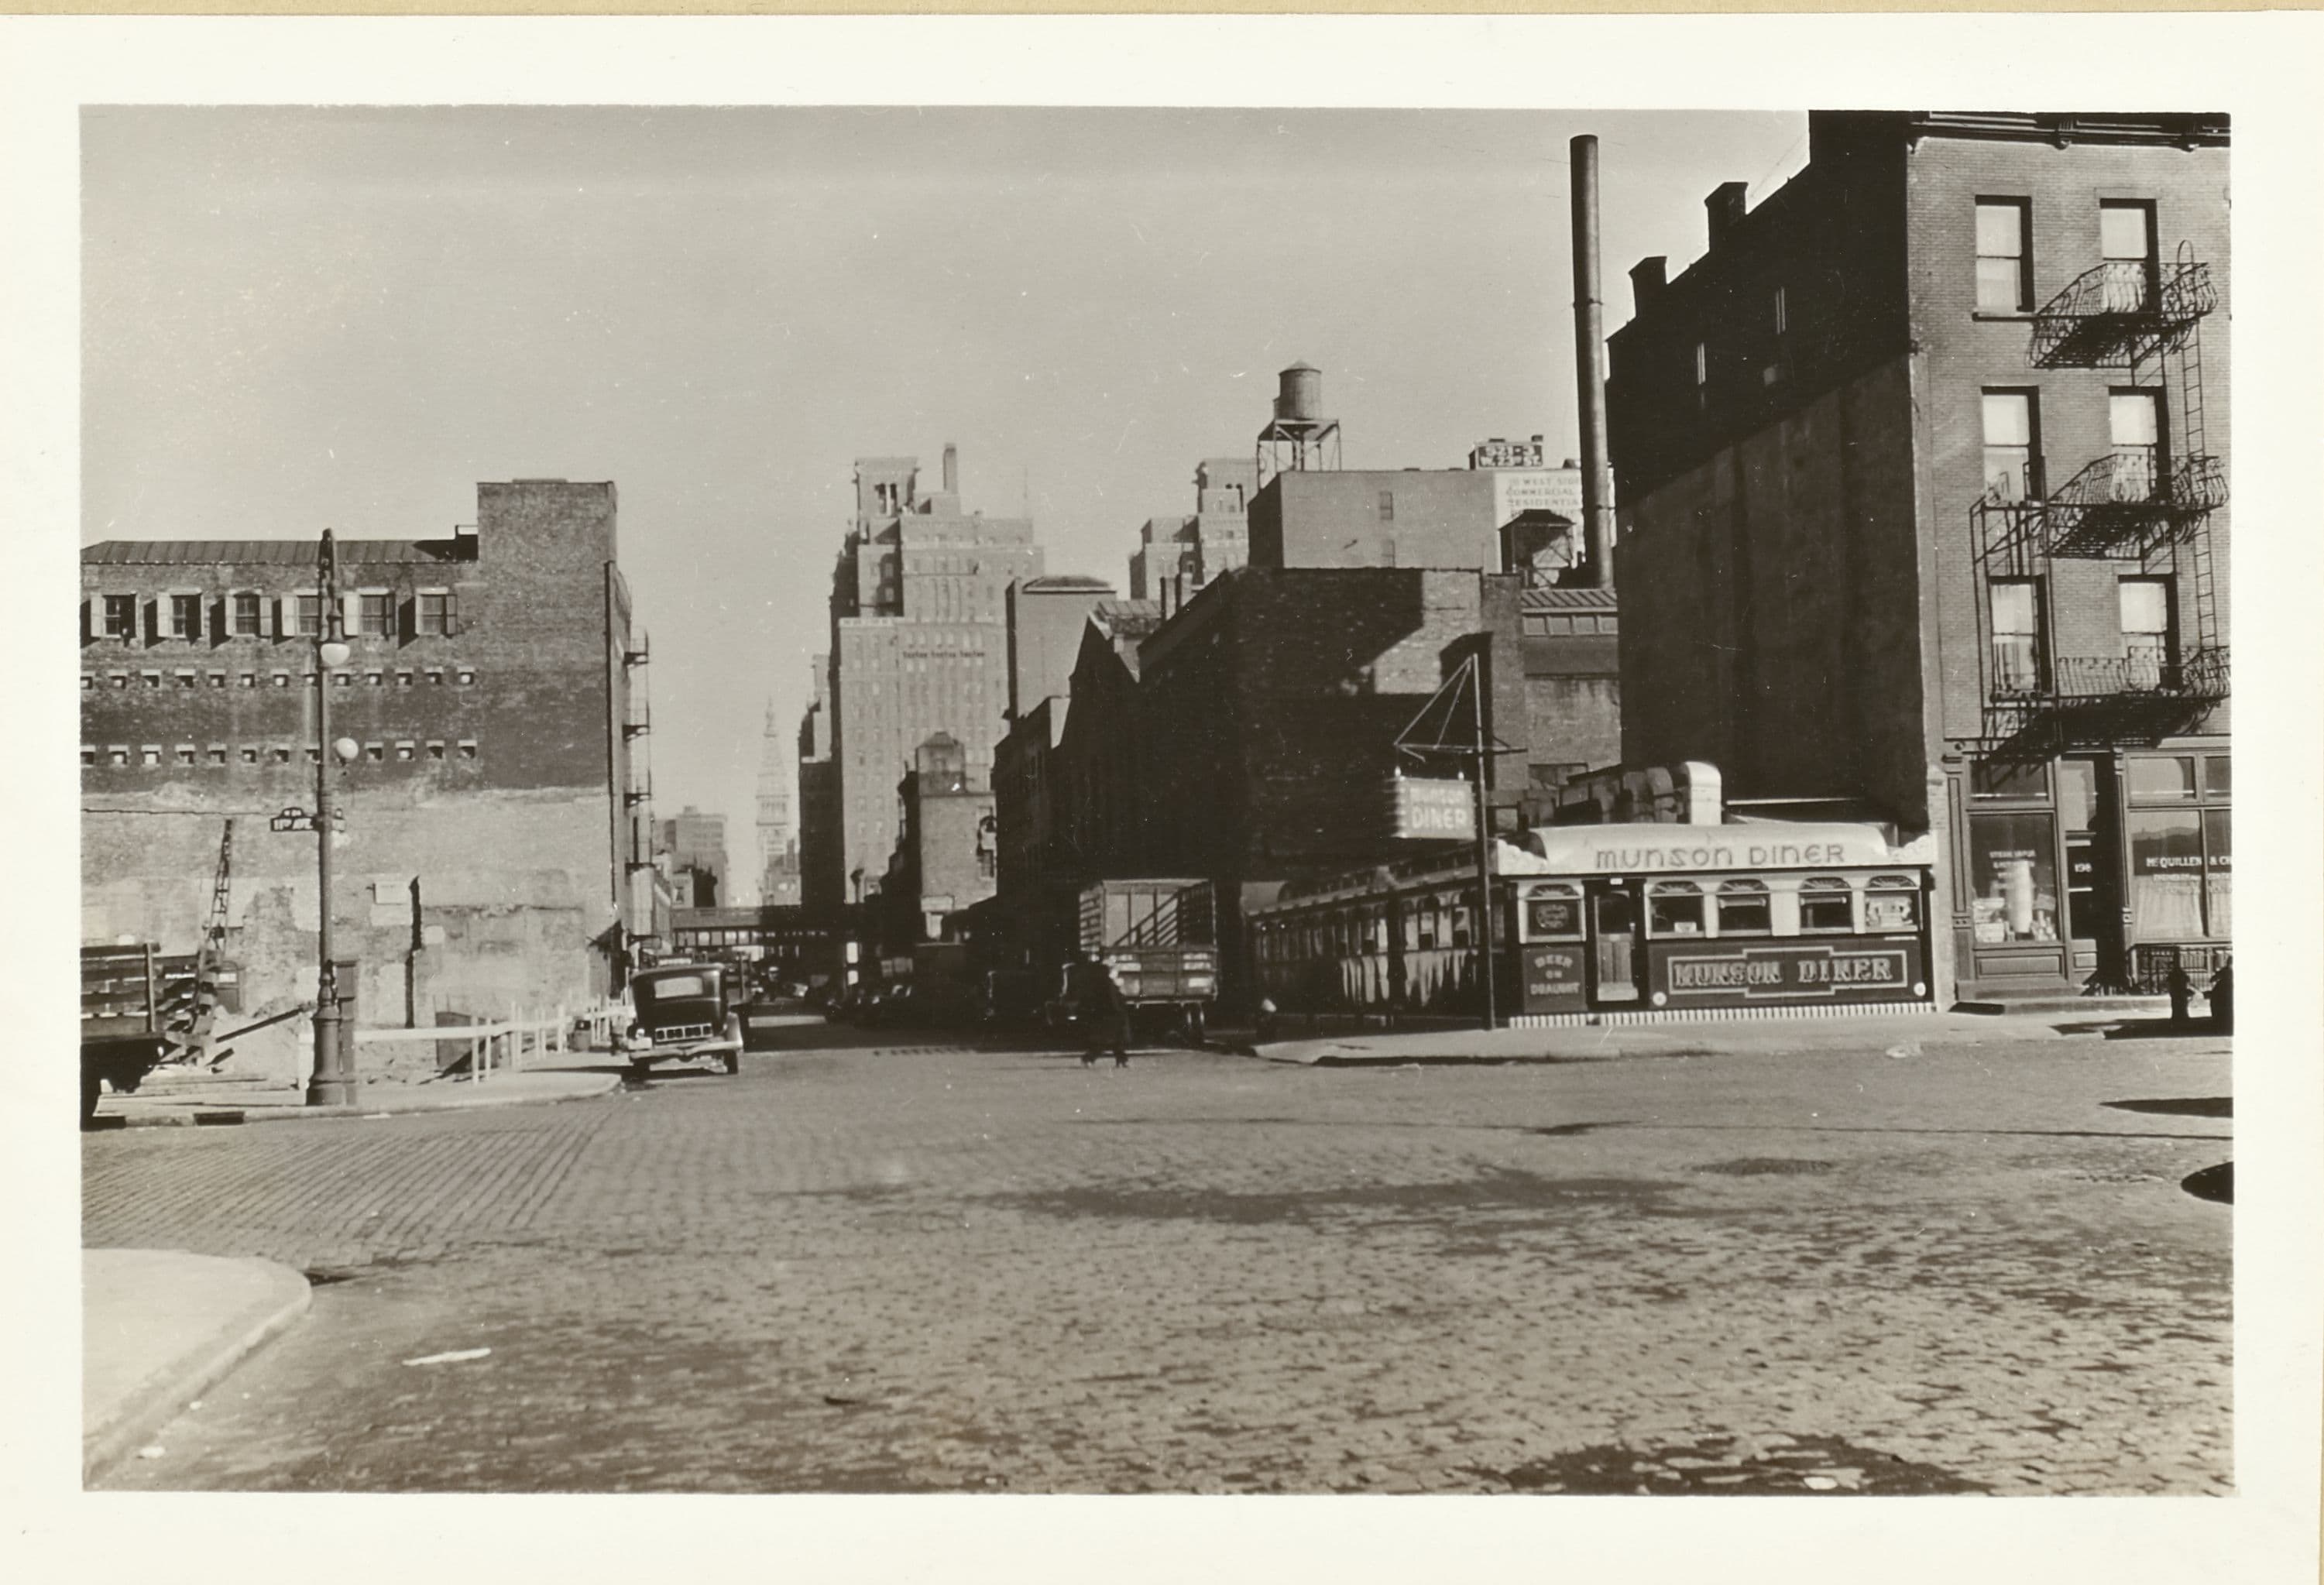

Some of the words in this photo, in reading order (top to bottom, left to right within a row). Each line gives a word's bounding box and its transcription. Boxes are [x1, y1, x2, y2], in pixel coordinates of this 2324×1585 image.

[1507, 498, 1580, 507] RESIDENTIA
[1411, 806, 1468, 829] DINER
[1596, 846, 1733, 869] MUNSON
[1749, 843, 1845, 866] DINER
[1535, 955, 1573, 968] BEER
[1546, 970, 1563, 979] ON
[1674, 961, 1783, 987] MUNSON
[1797, 957, 1893, 983] DINER
[1530, 982, 1580, 995] DRAUGHT
